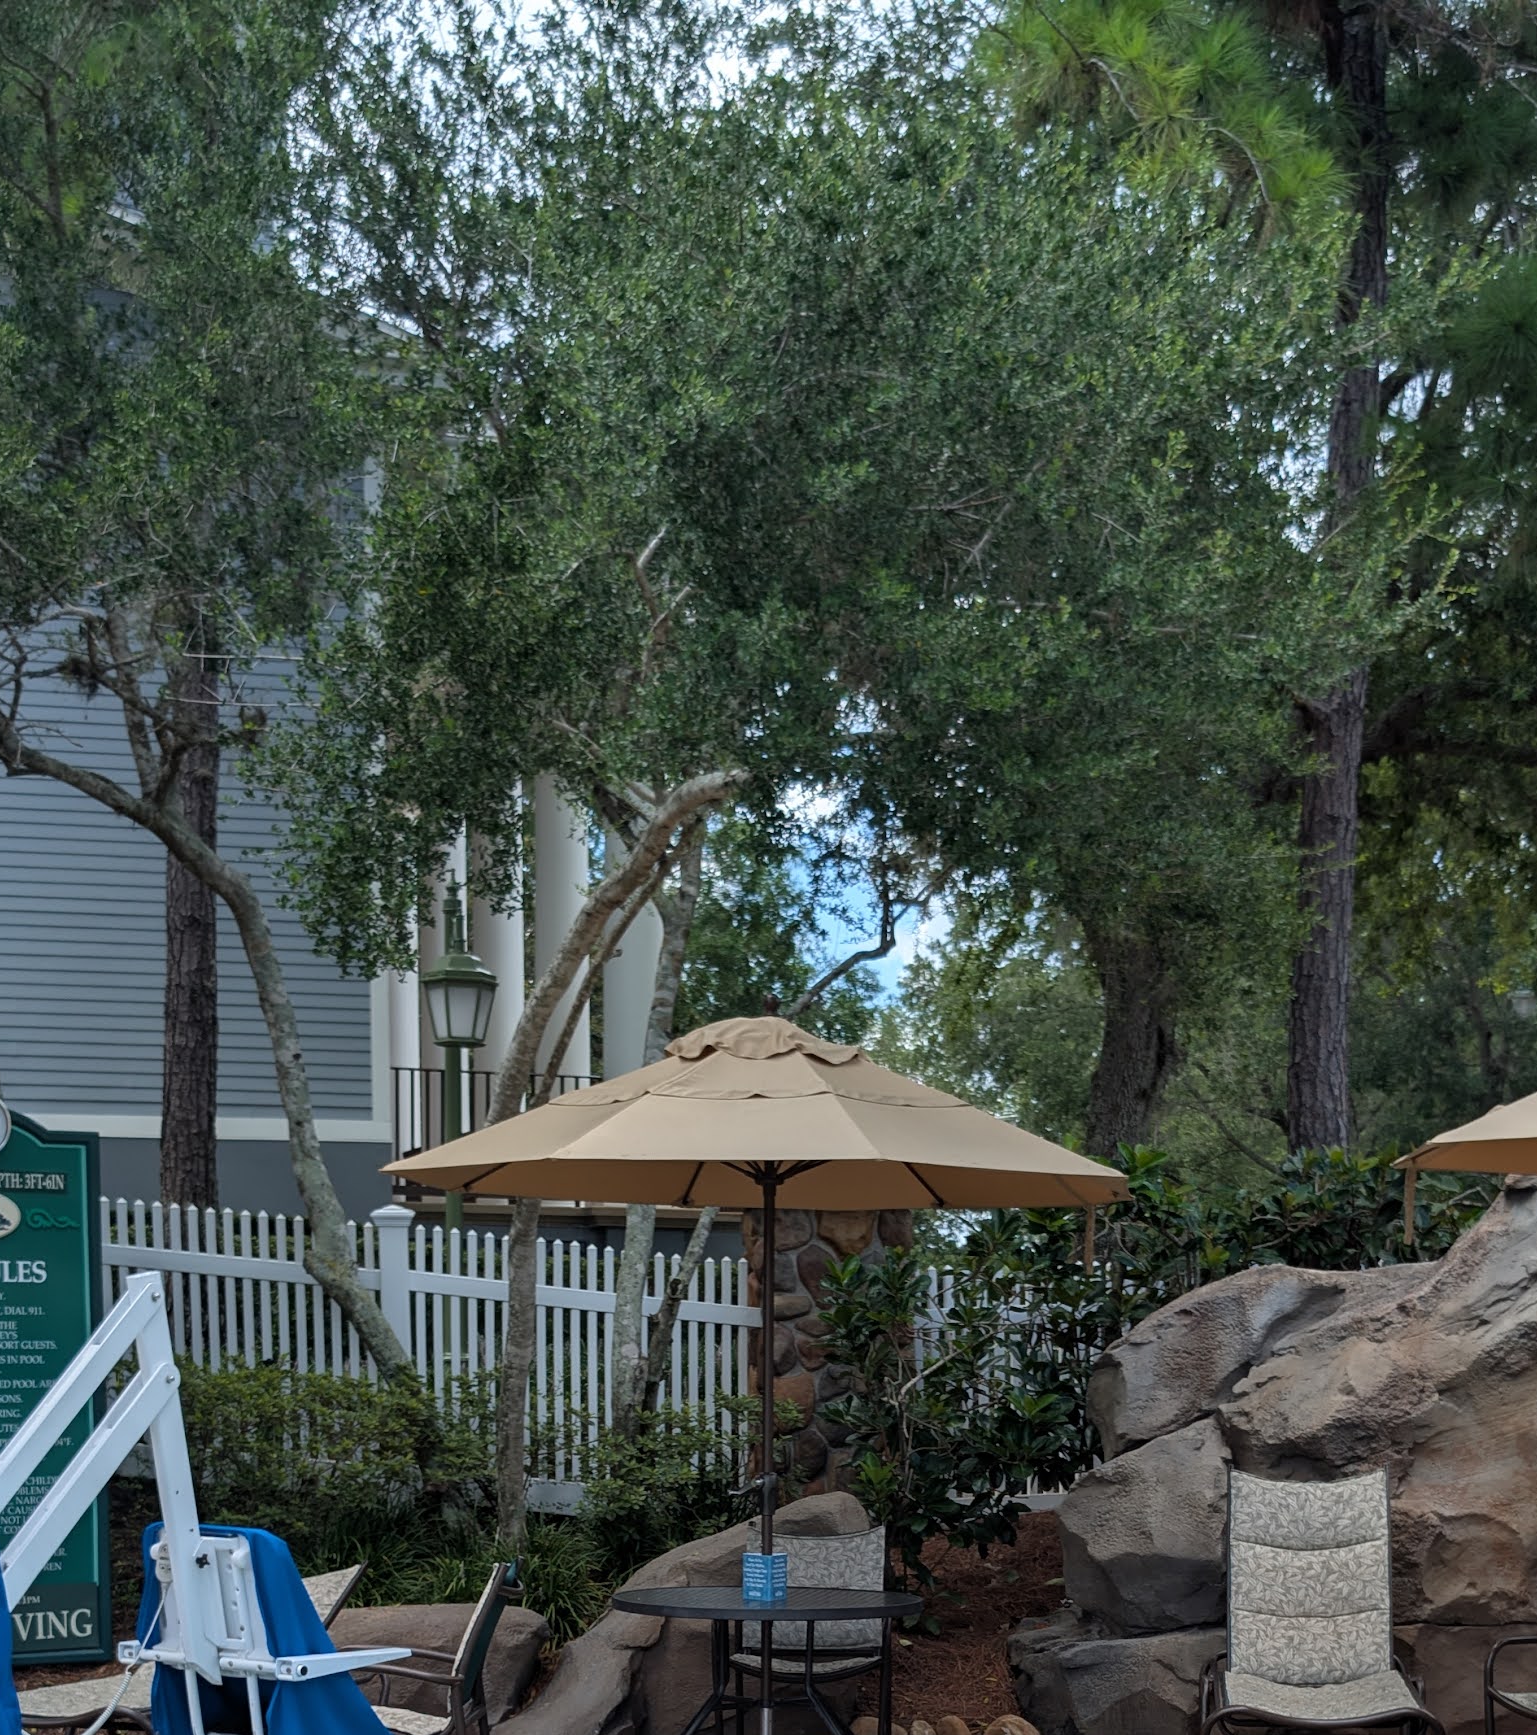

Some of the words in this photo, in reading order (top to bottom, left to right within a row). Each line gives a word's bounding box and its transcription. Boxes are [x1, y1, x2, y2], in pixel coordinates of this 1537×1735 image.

[24, 1173, 65, 1190] 3FT-6IN
[4, 1306, 27, 1316] DIAL
[28, 1306, 46, 1316] 911.
[20, 1340, 58, 1350] GUESTS.
[7, 1355, 18, 1364] IN
[19, 1355, 45, 1364] POOL
[13, 1380, 38, 1389] POOL
[0, 1516, 22, 1525] NOT
[12, 1608, 93, 1641] VING
